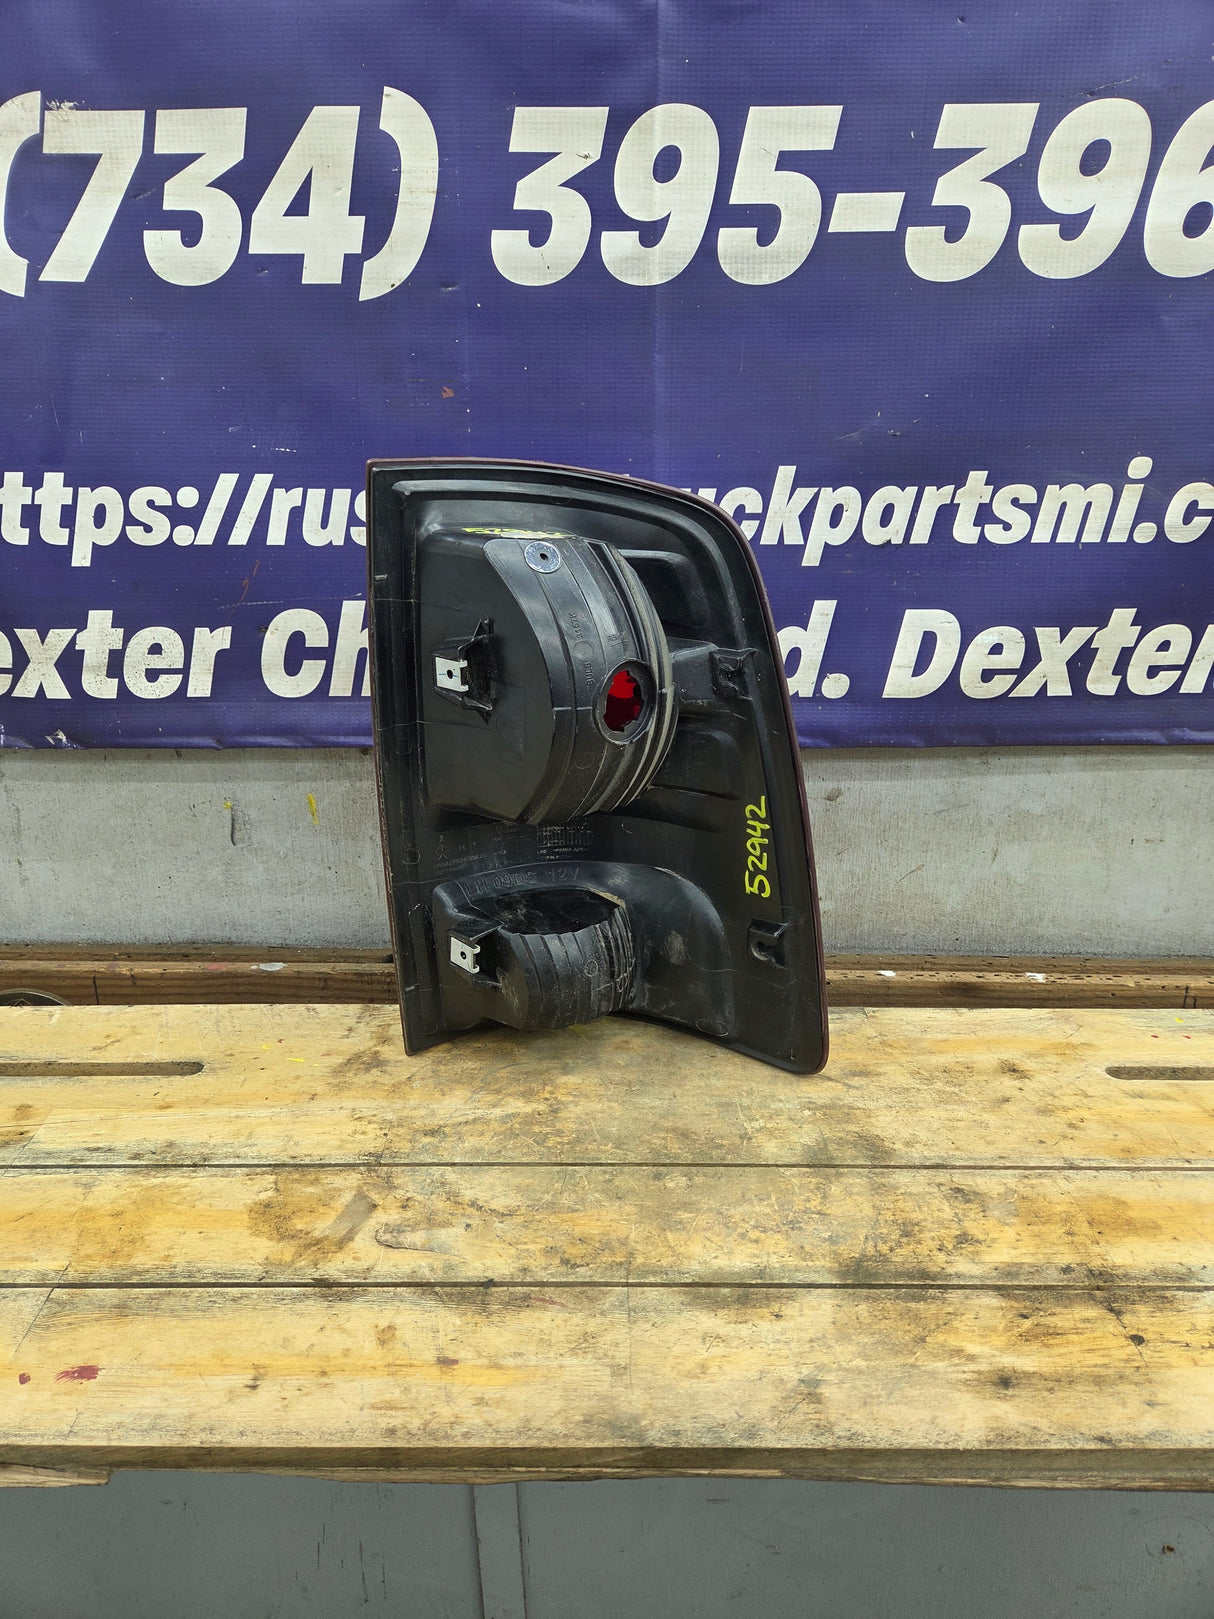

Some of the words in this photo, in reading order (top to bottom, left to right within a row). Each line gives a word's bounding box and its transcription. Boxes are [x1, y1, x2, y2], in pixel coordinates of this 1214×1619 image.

[0, 86, 439, 301] (734)
[0, 610, 232, 699] xter
[882, 607, 1214, 699] Dexter
[744, 795, 771, 898] 52942
